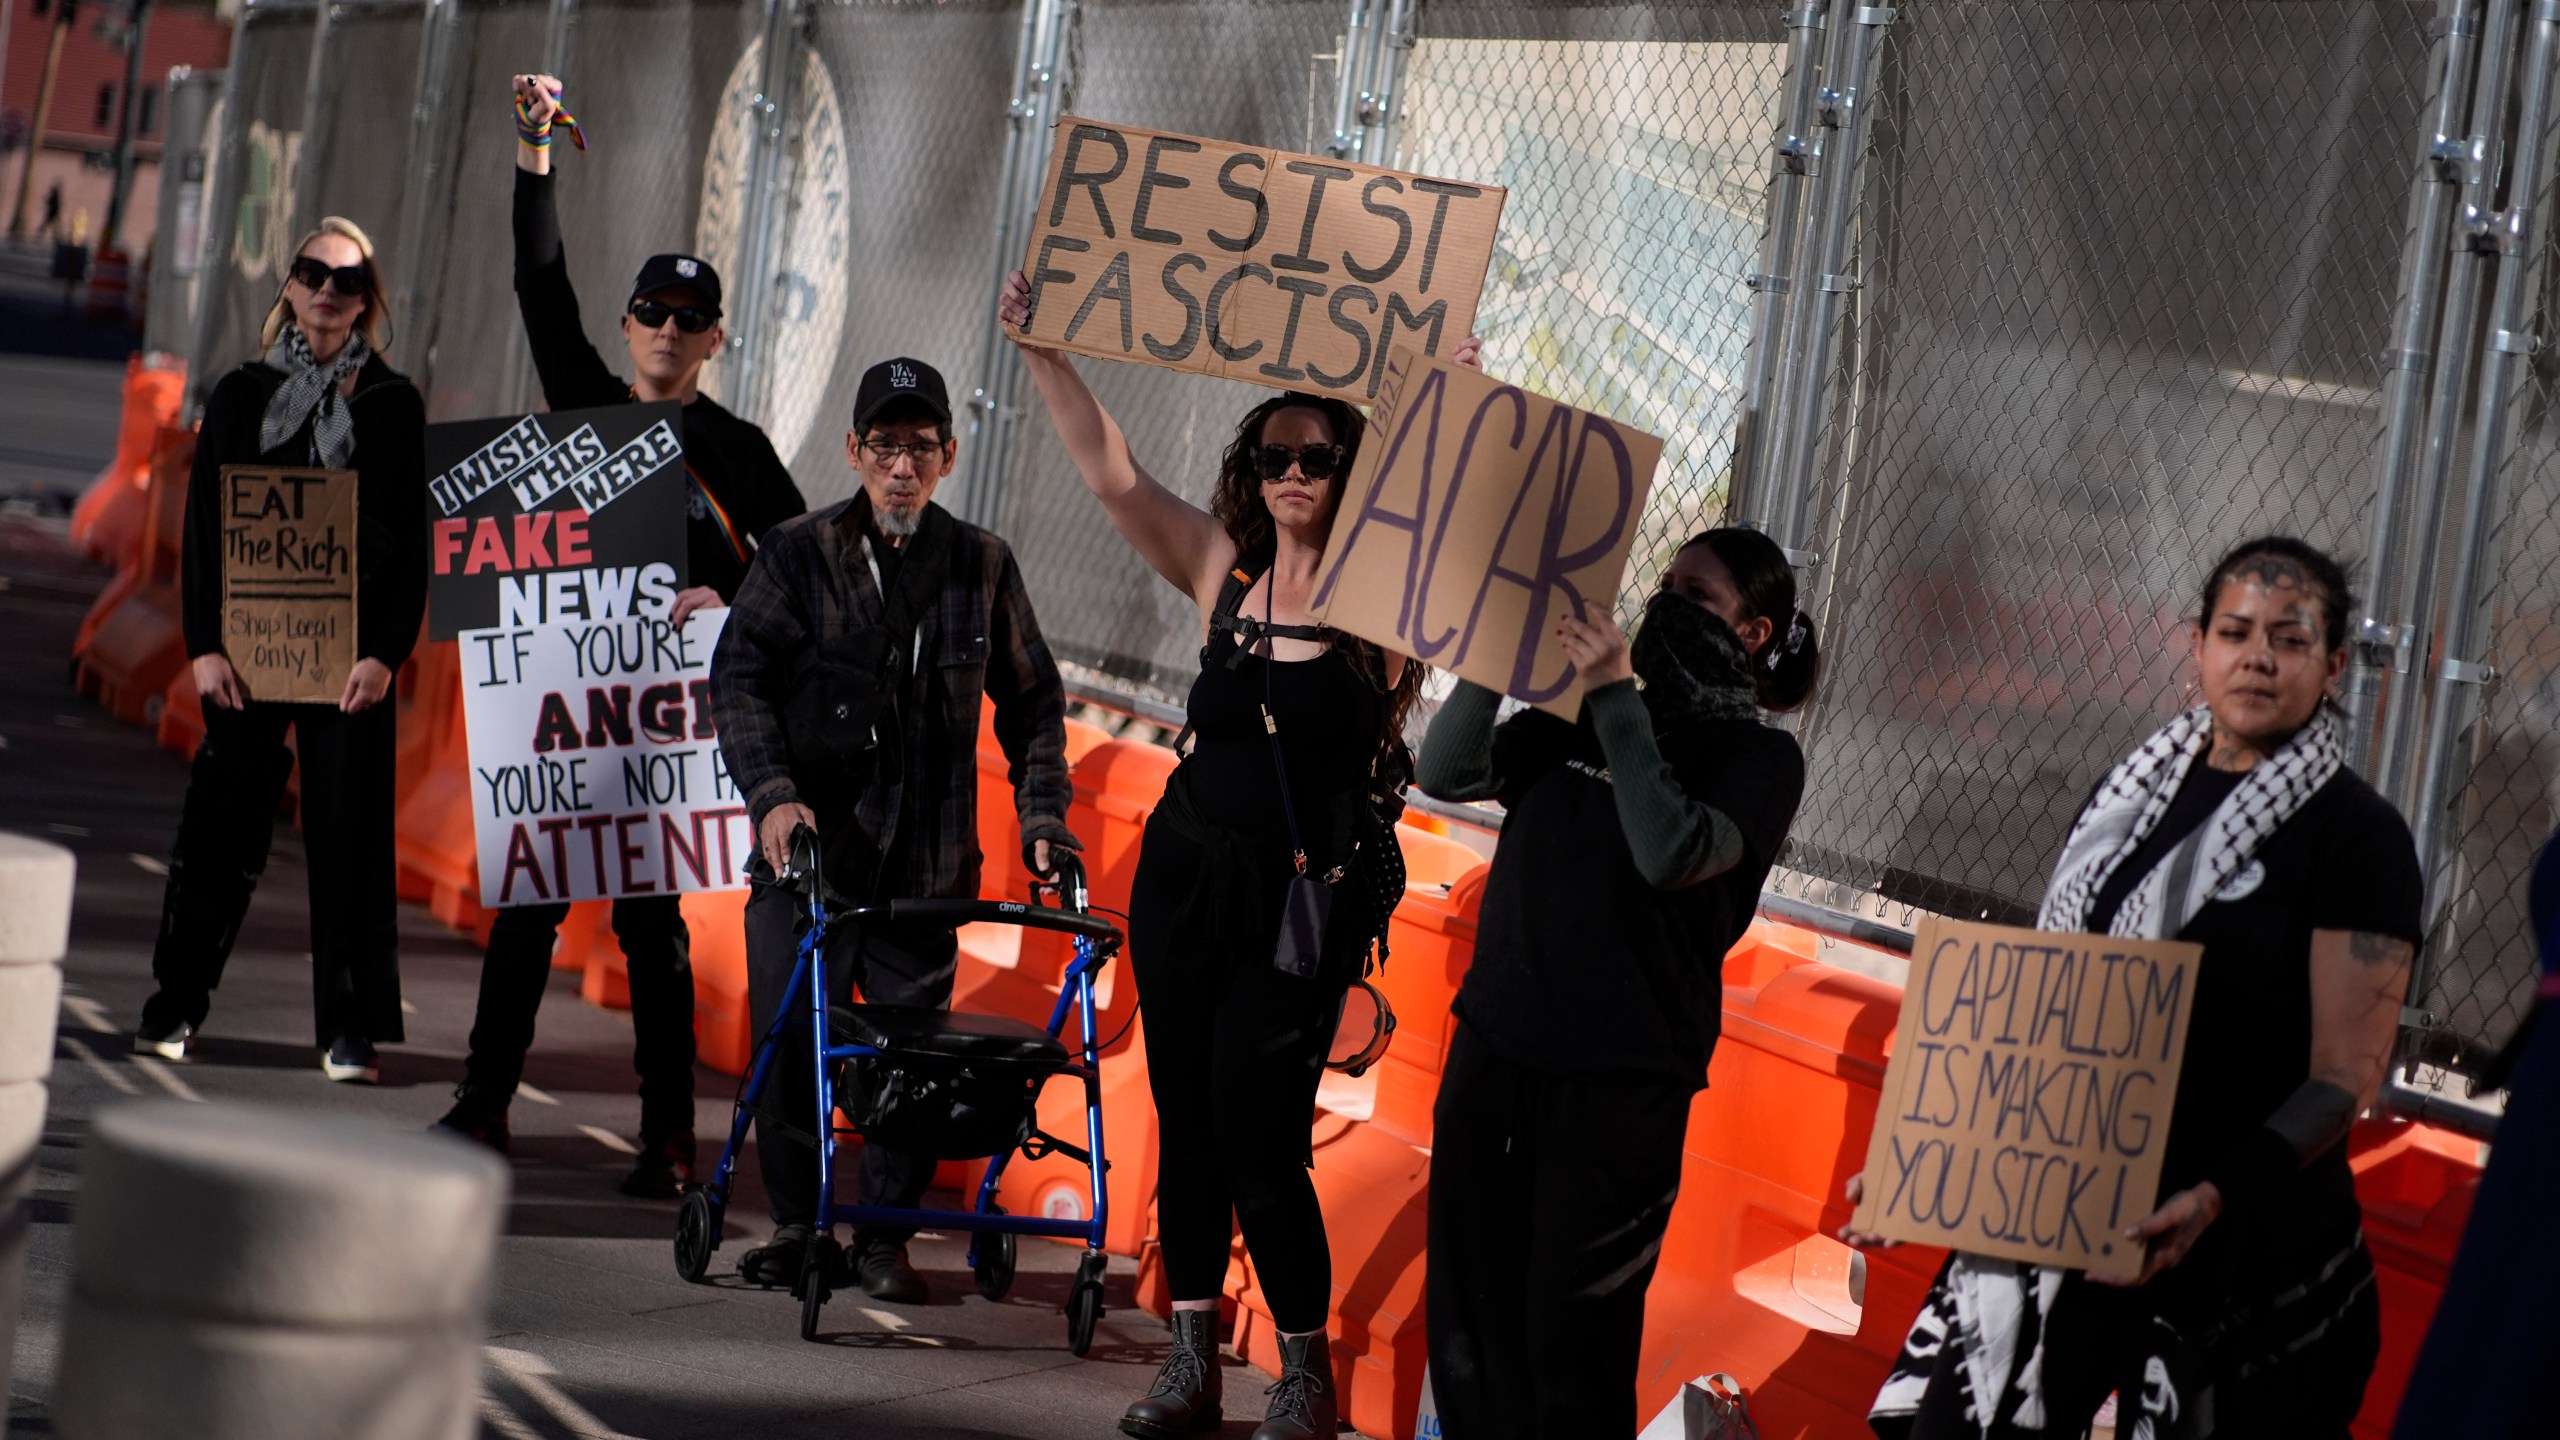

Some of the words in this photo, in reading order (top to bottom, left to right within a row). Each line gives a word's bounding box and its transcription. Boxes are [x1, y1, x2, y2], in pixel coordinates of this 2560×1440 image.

[1049, 124, 1482, 294] RESIST
[1019, 234, 1448, 399] FASCISM
[890, 362, 917, 388] LA
[1370, 361, 1404, 438] 1312!
[231, 474, 327, 521] EAT
[432, 478, 459, 510] I
[451, 419, 549, 498] WISH
[511, 427, 603, 504] THIS
[574, 424, 682, 511] WERE
[275, 525, 348, 576] Rich
[433, 508, 592, 576] FAKE
[1311, 367, 1634, 704] ACAB
[229, 608, 281, 644] Shop
[286, 610, 336, 641] Local
[499, 562, 677, 629] NEWS
[473, 630, 535, 688] IF
[563, 615, 704, 678] YOU'RE
[477, 755, 593, 818] YOU'RE
[622, 749, 697, 808] NOT
[499, 806, 756, 902] ATTENT
[999, 902, 1025, 913] drive
[1921, 937, 2185, 1063] CAPITALISM
[1902, 1041, 1970, 1129] IS
[1968, 1049, 2156, 1158] MAKING
[1886, 1135, 1980, 1231] YOU
[1980, 1145, 2127, 1257] SICK!
